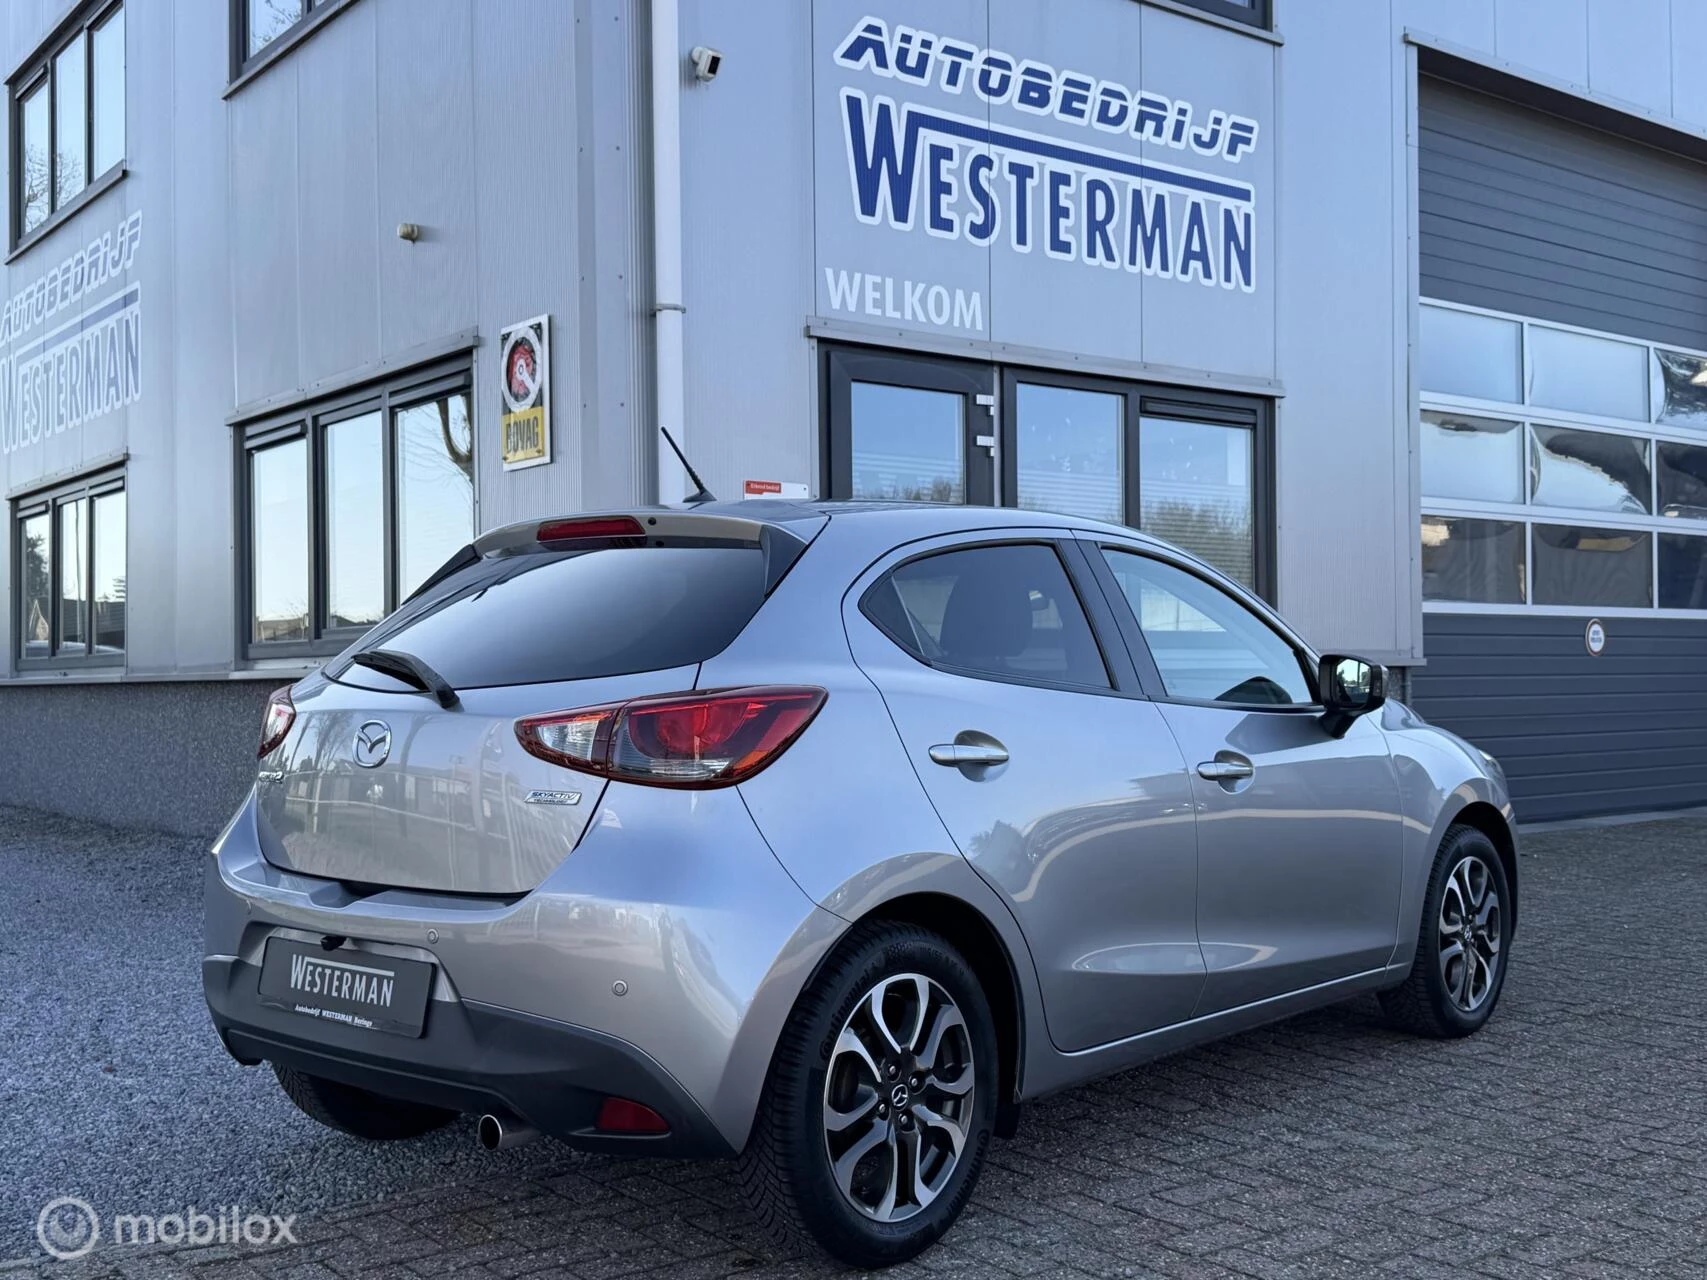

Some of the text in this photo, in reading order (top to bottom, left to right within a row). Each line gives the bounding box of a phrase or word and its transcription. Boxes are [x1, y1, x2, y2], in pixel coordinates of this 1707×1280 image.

[834, 16, 1258, 161] AUTOBEDRIJF
[840, 88, 1256, 292] WESTERMAN
[0, 209, 142, 347] AUTOBEDRIJF
[824, 268, 983, 331] WELKOM
[0, 281, 142, 454] WESTERMAN
[506, 416, 539, 453] BOVAG
[290, 954, 394, 1007] WESTERMAN
[322, 1010, 352, 1023] WESTERMAN
